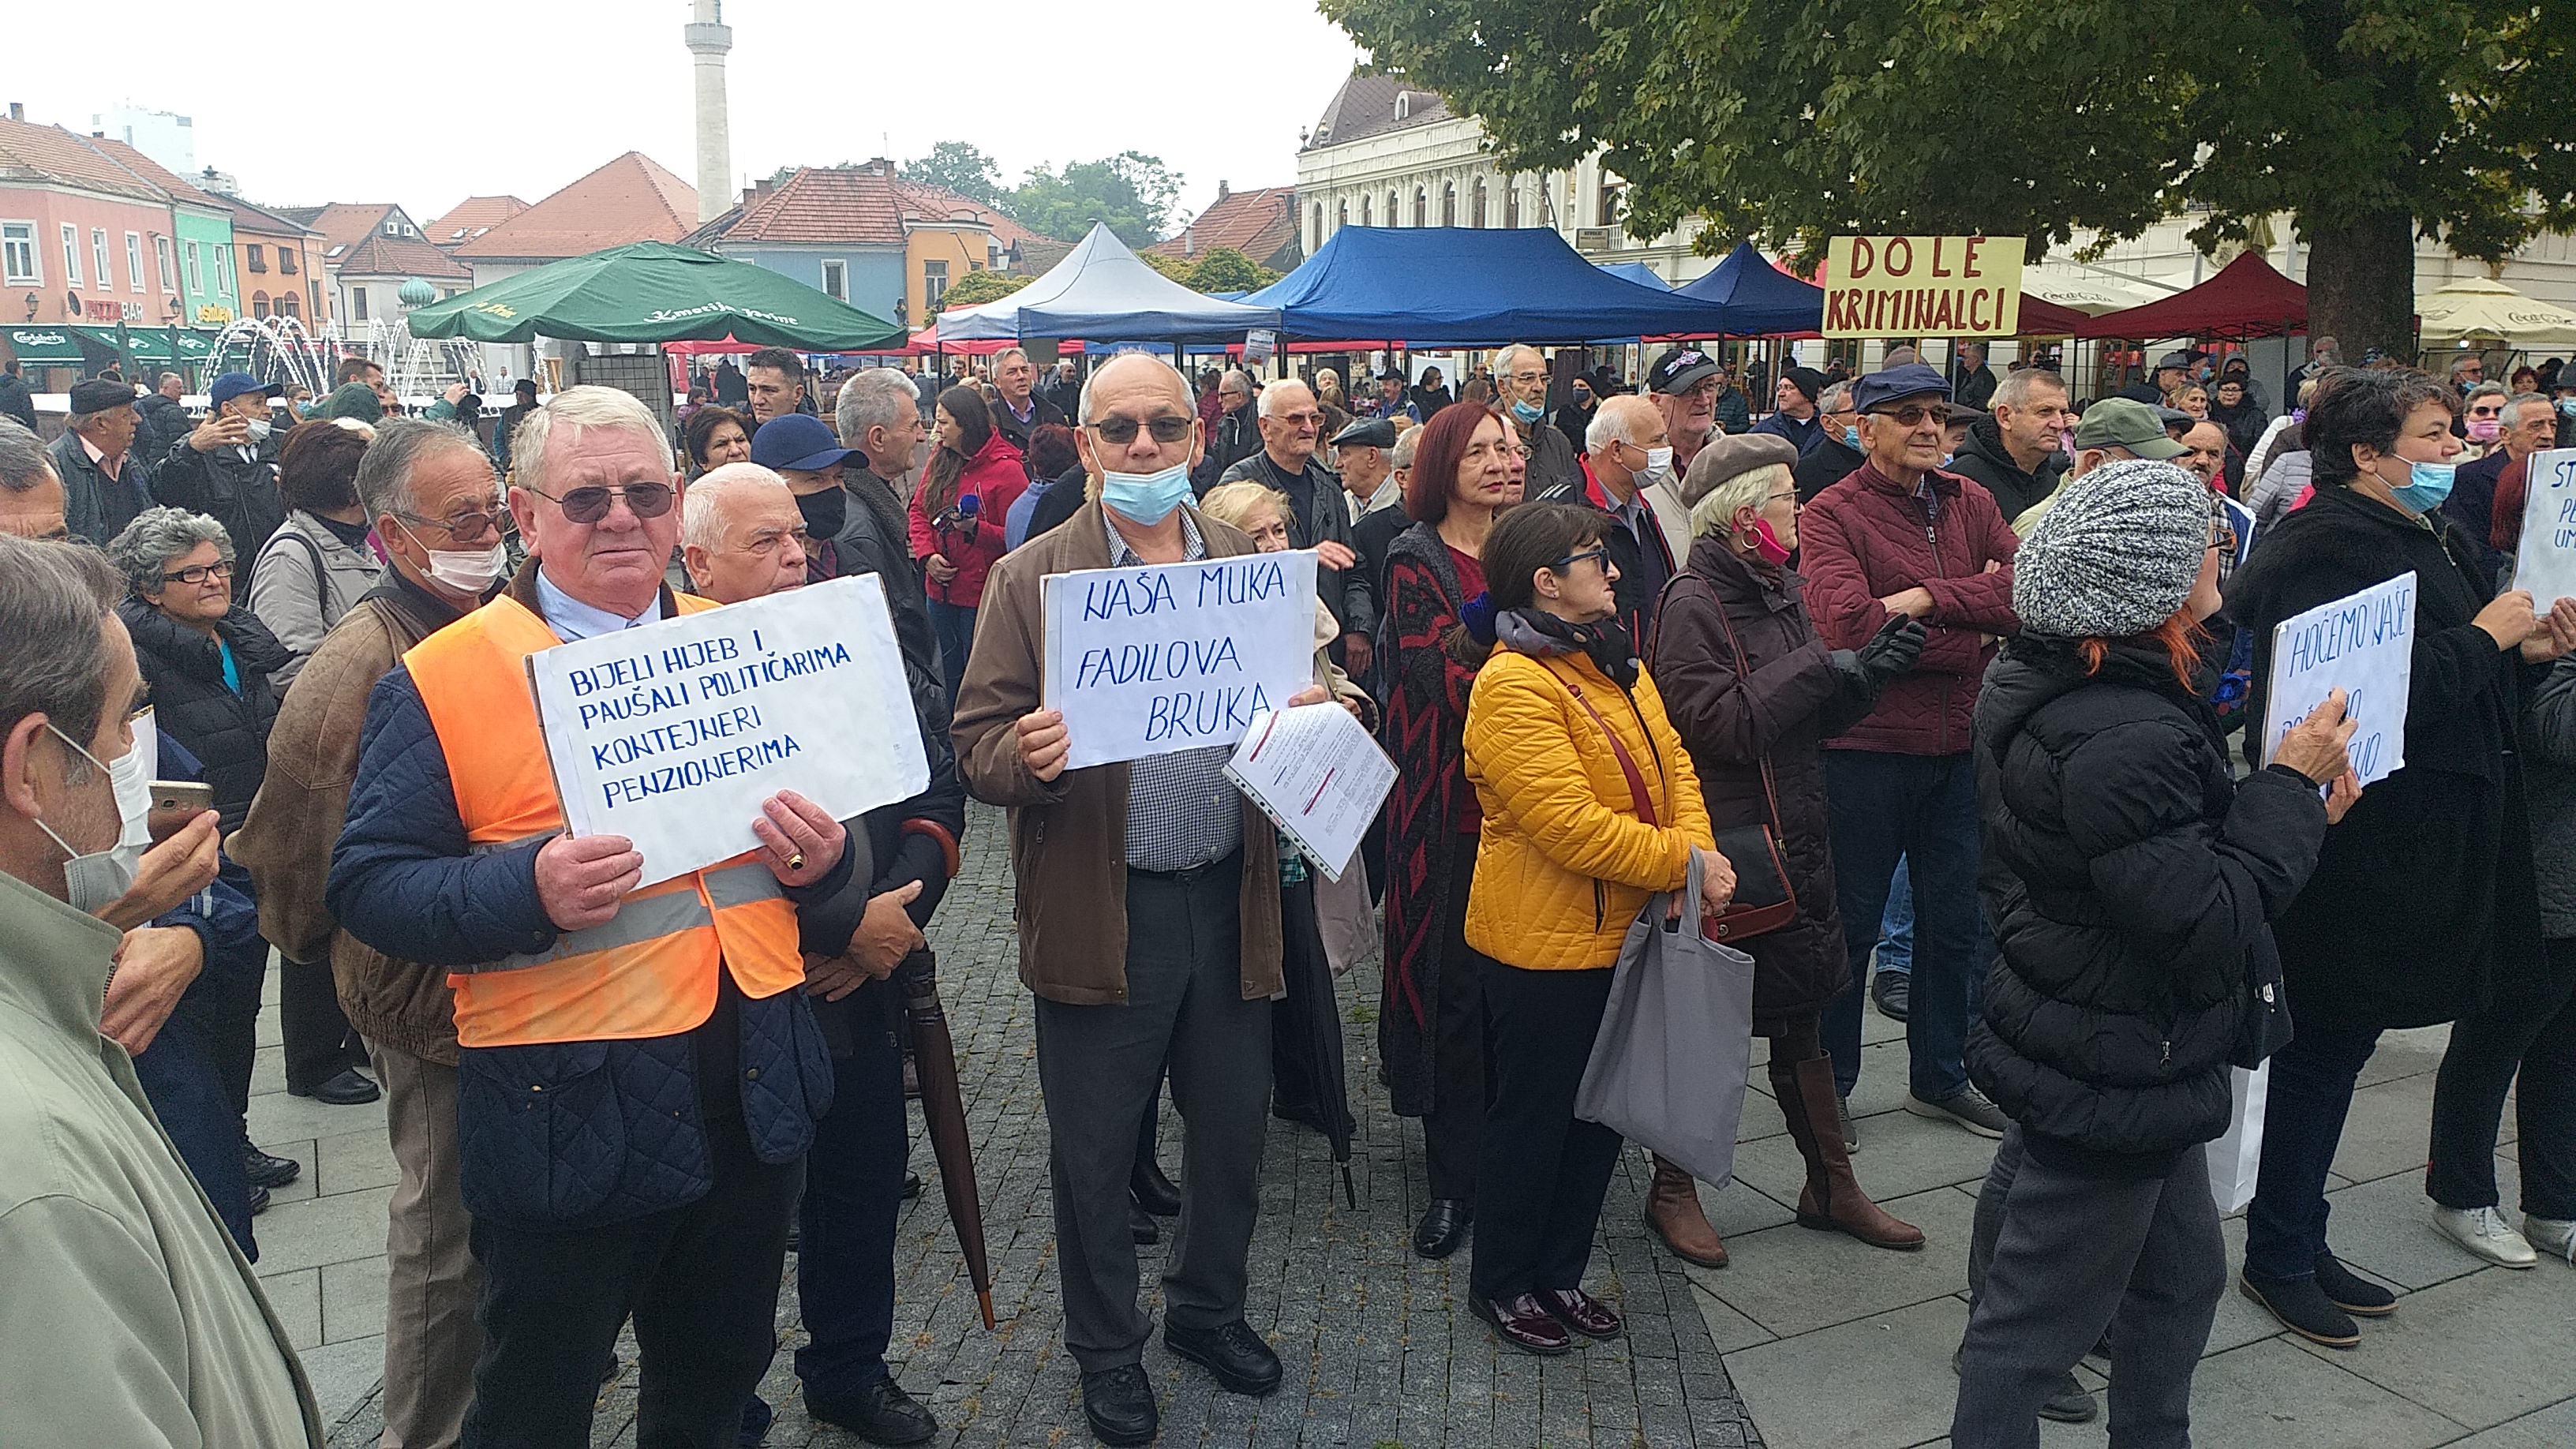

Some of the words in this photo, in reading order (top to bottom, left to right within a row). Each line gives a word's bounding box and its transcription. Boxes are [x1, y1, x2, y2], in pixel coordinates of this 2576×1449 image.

[1850, 237, 1986, 279] DOLE
[13, 331, 66, 346] Carlsberg
[122, 301, 143, 320] BAR
[1826, 288, 2005, 331] KRIMINALCI
[1083, 571, 1177, 622] NAŠA
[1197, 560, 1286, 608] MUKA
[569, 653, 655, 697] BIJELI
[662, 637, 739, 674] HLJEB
[752, 629, 763, 652] I
[578, 681, 691, 730] PAUŠALI
[698, 642, 852, 700] POLITIČARIMA
[1076, 636, 1242, 690] FADILOVA
[591, 705, 762, 771] KONTEJNERI
[1145, 682, 1271, 742] BRUKA
[601, 733, 802, 809] PENZIONERIMA
